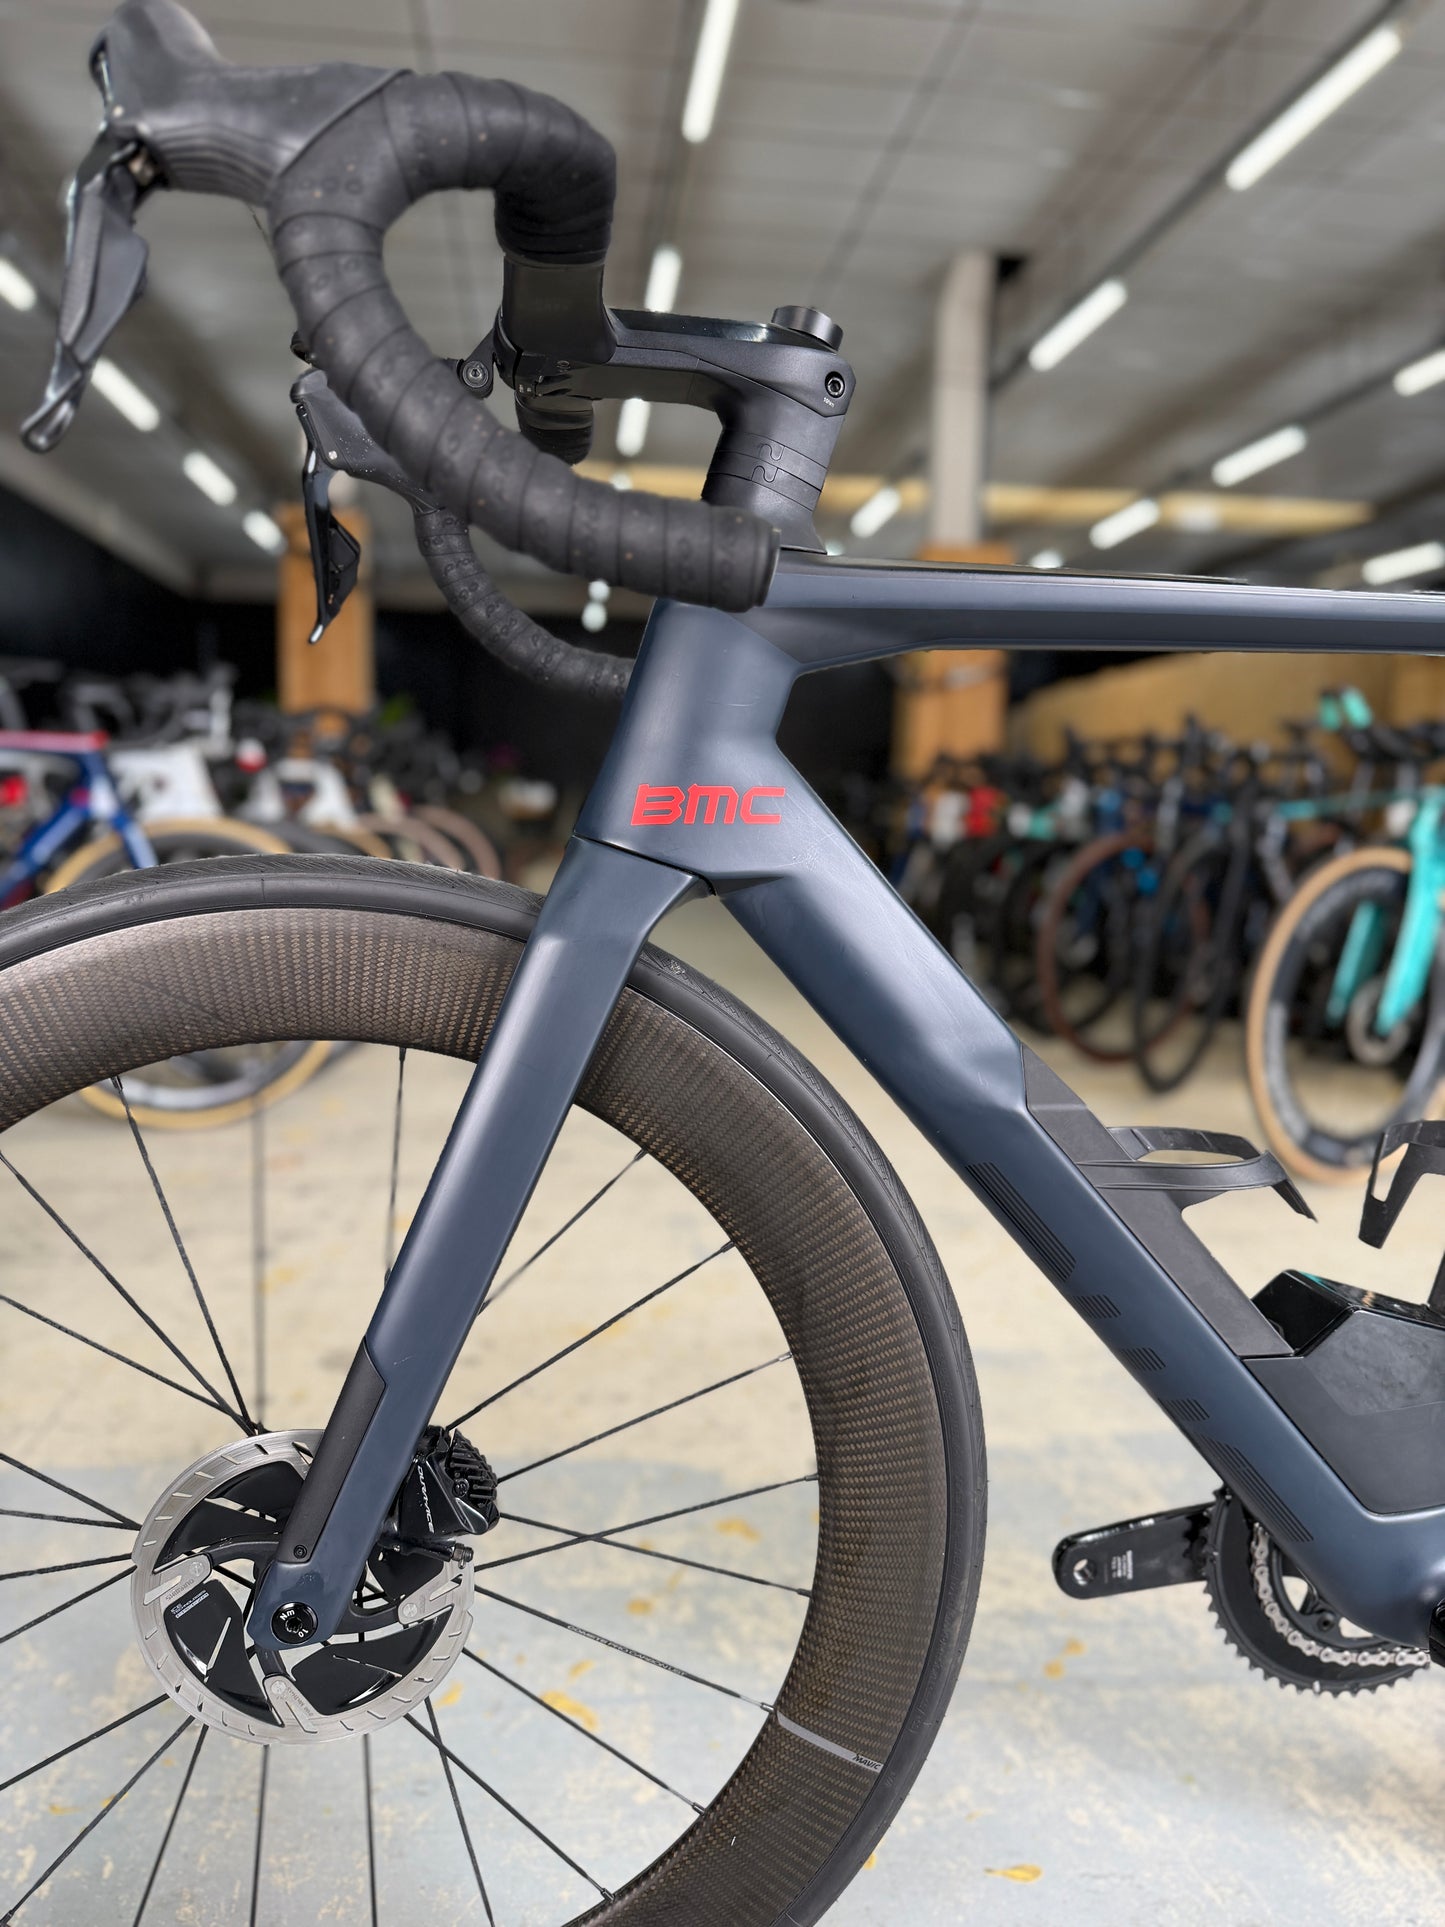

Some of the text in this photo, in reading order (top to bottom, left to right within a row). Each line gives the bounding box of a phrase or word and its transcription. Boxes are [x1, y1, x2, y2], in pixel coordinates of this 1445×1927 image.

[631, 783, 786, 826] BMC
[280, 1609, 296, 1621] Nm
[298, 1628, 309, 1638] 10
[852, 1752, 882, 1770] MAVIC
